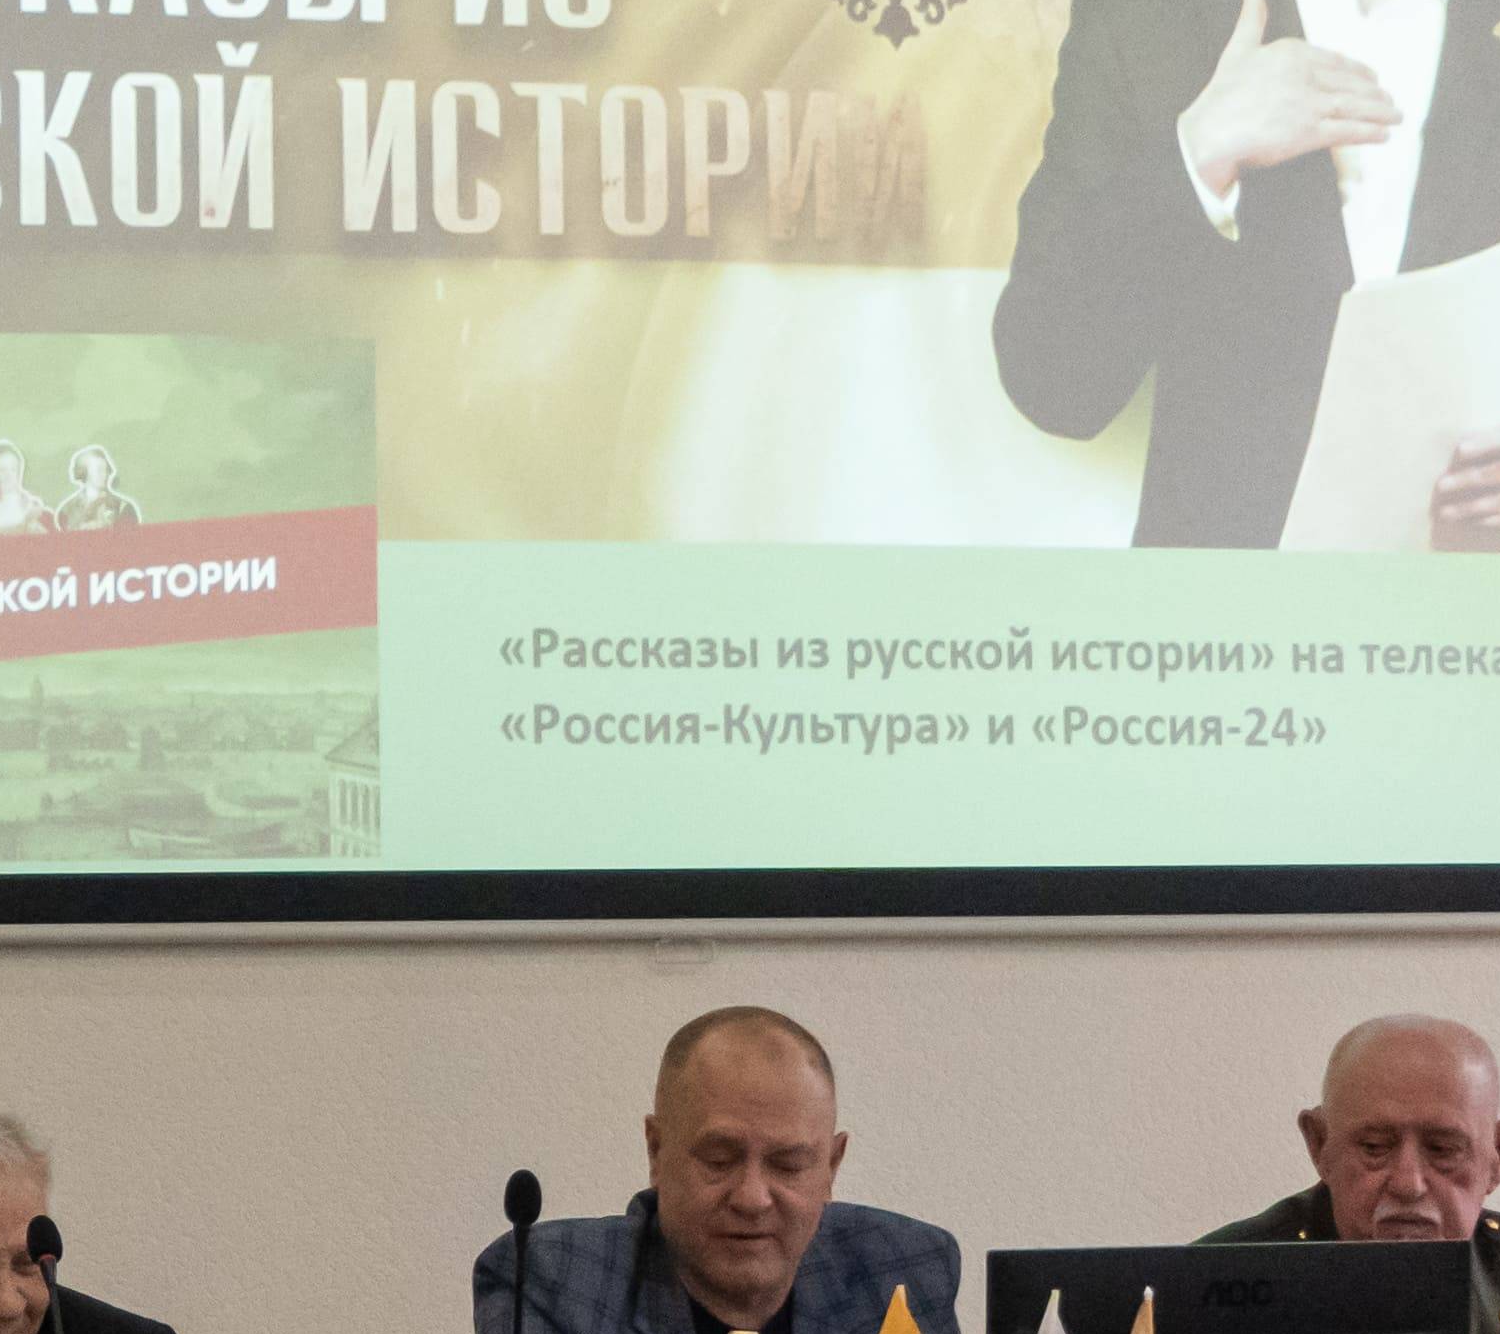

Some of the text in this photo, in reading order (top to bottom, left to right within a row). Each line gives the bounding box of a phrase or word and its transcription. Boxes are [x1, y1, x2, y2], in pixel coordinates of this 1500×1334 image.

[89, 557, 277, 604] ИСТОРИИ
[499, 628, 758, 669] «Рассказы
[777, 638, 829, 669] из
[846, 626, 1033, 680] русской
[1051, 639, 1275, 683] истории»
[1292, 642, 1344, 674] на
[500, 703, 1328, 755] «Россия-Культура» и «Россия-24»
[1202, 1278, 1272, 1307] AOC
